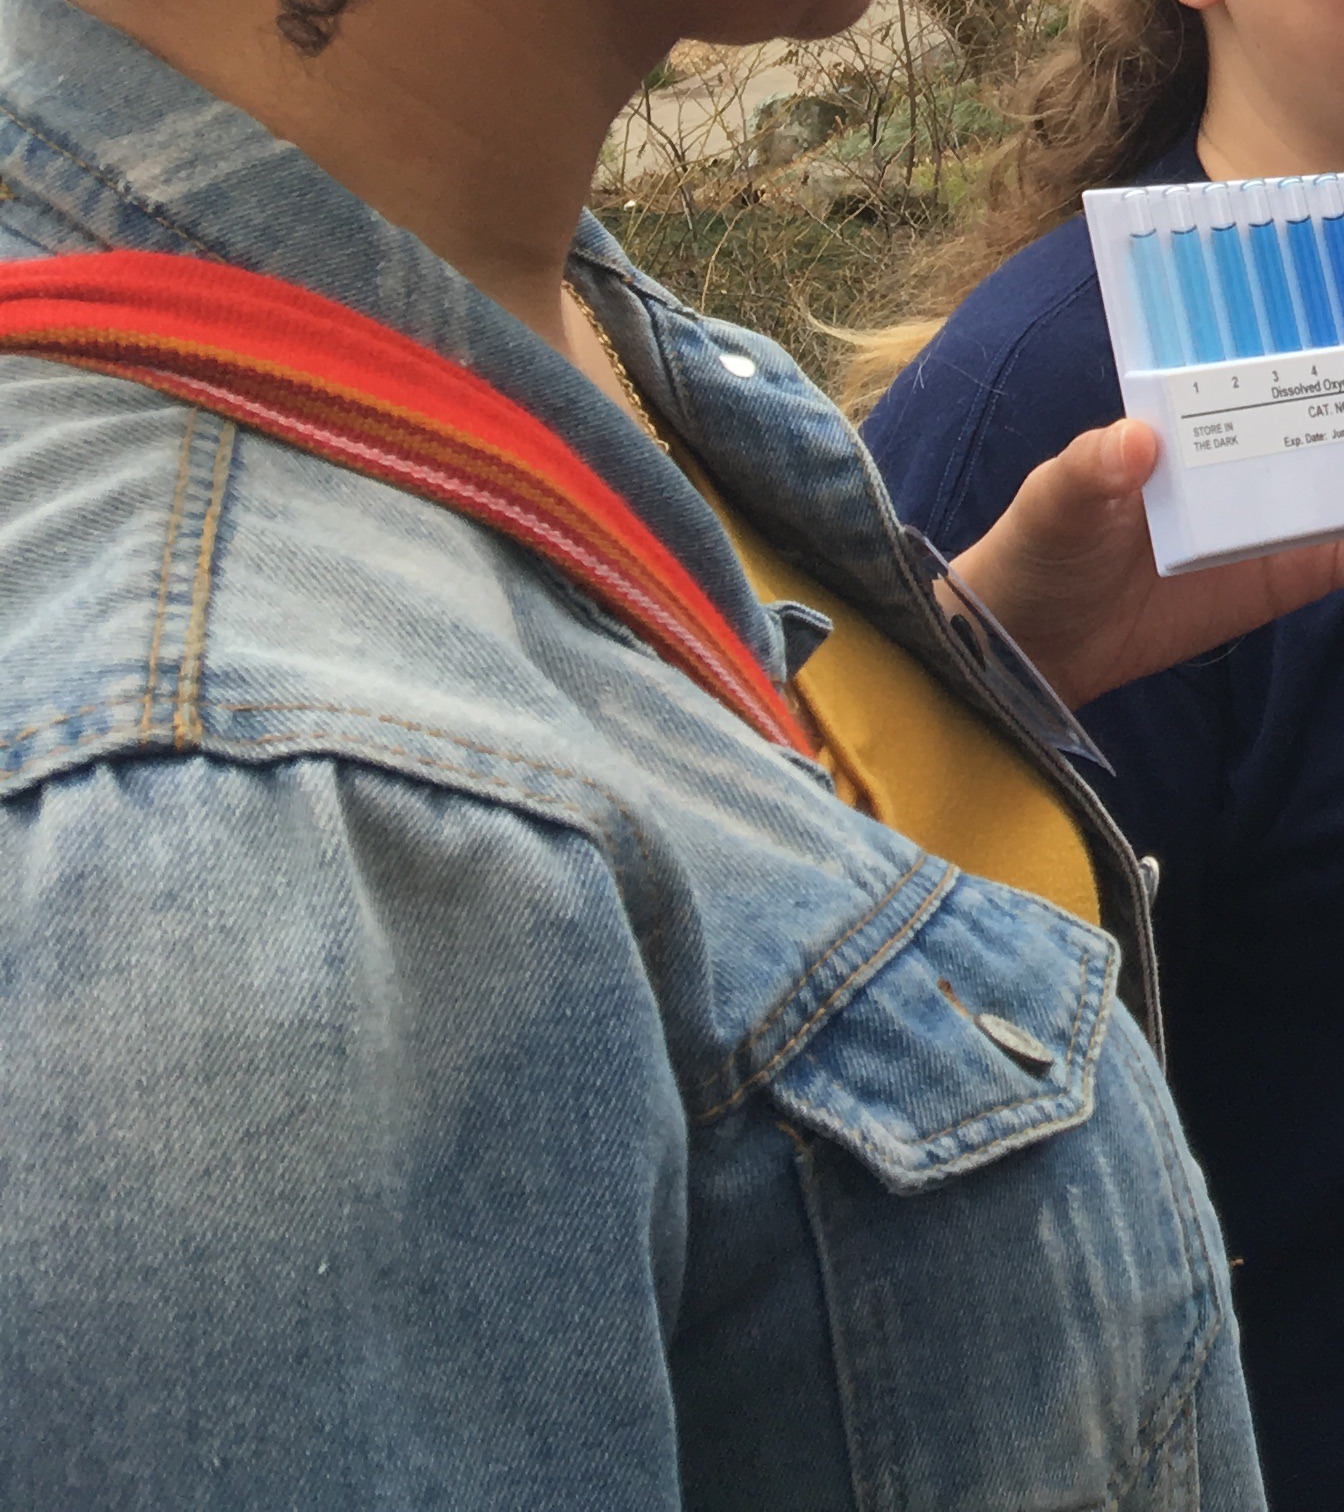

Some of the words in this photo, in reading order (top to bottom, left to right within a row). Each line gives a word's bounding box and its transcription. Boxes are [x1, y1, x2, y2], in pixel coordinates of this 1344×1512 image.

[1193, 381, 1200, 394] 1
[1231, 376, 1239, 389] 2
[1272, 370, 1279, 383] 3
[1311, 365, 1318, 376] 4
[1271, 380, 1321, 399] Dissolved
[1308, 403, 1333, 418] CAT.
[1193, 423, 1223, 437] STORE
[1224, 421, 1234, 433] IN
[1193, 440, 1211, 452] THE
[1213, 435, 1239, 449] DARK
[1283, 435, 1304, 448] Exp.
[1305, 432, 1327, 444] Date:
